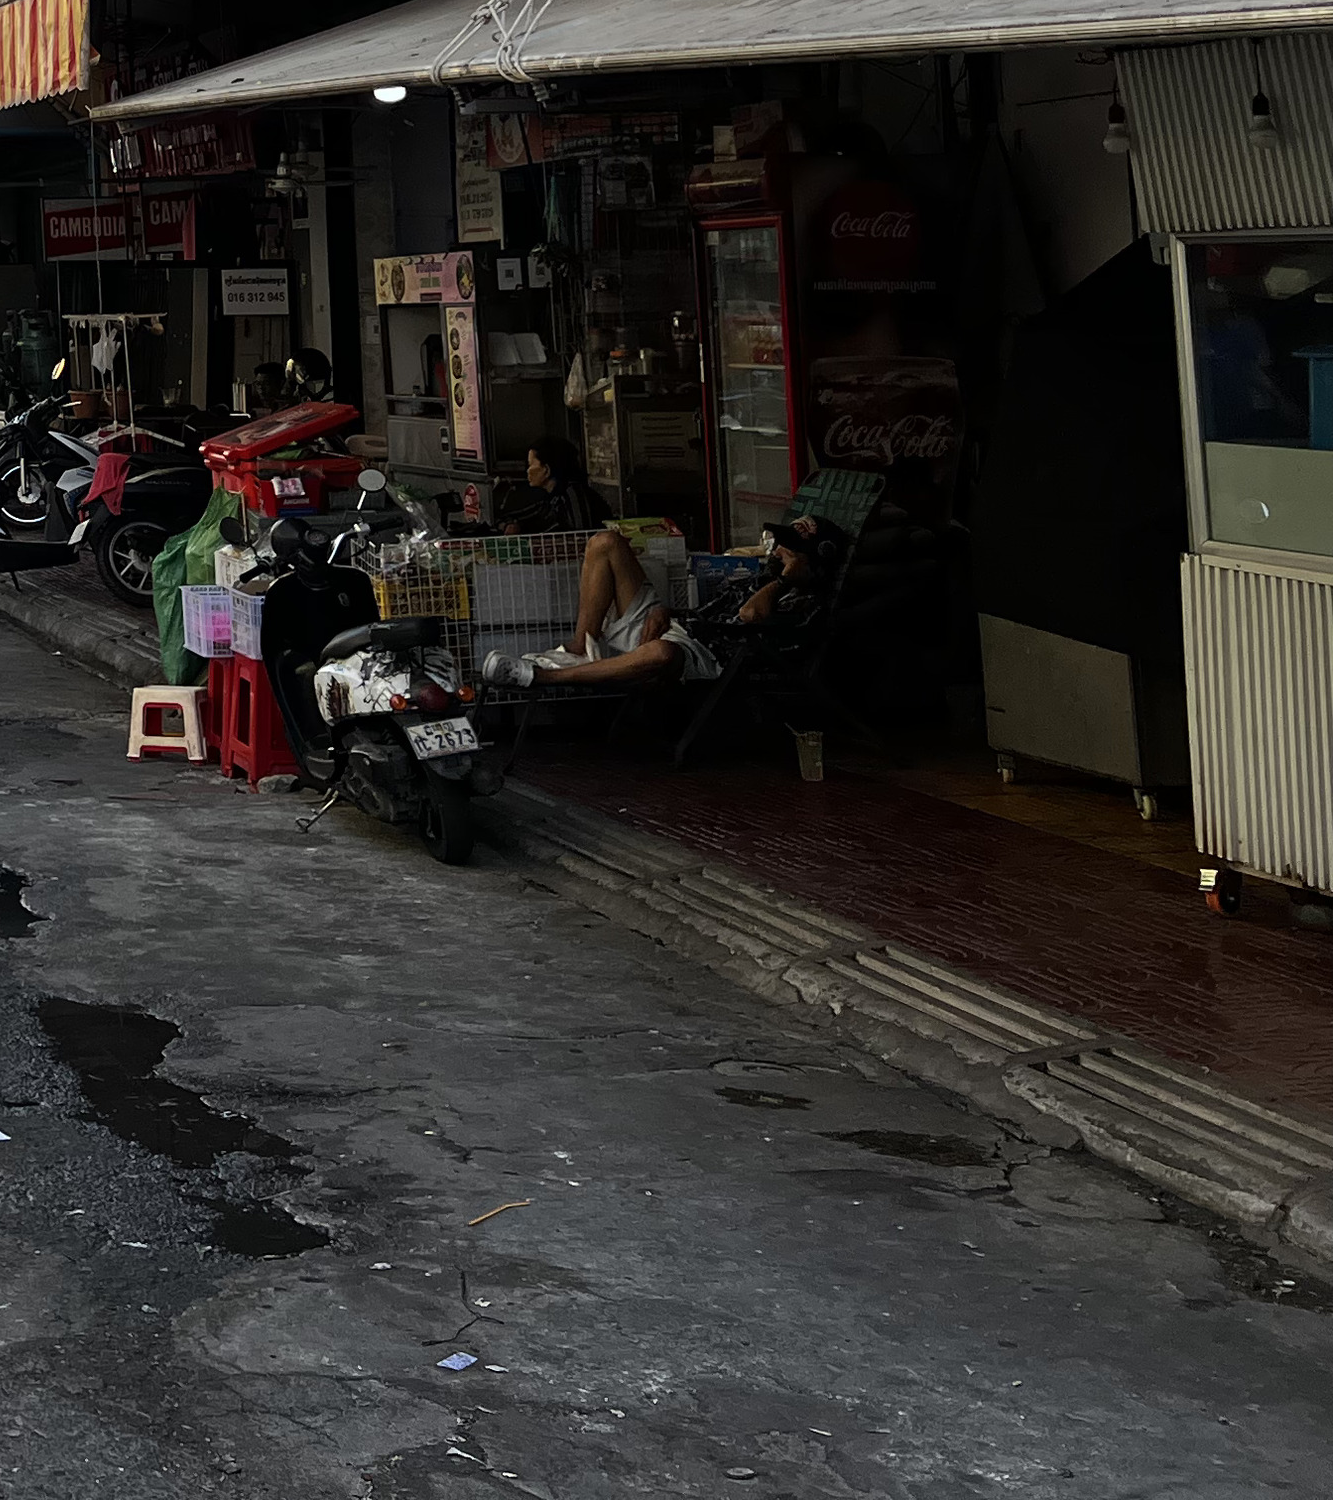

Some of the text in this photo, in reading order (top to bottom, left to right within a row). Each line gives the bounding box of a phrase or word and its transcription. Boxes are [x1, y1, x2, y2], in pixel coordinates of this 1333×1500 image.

[49, 215, 127, 239] CAMBODIA
[227, 292, 245, 302] 016
[247, 292, 265, 302] 312
